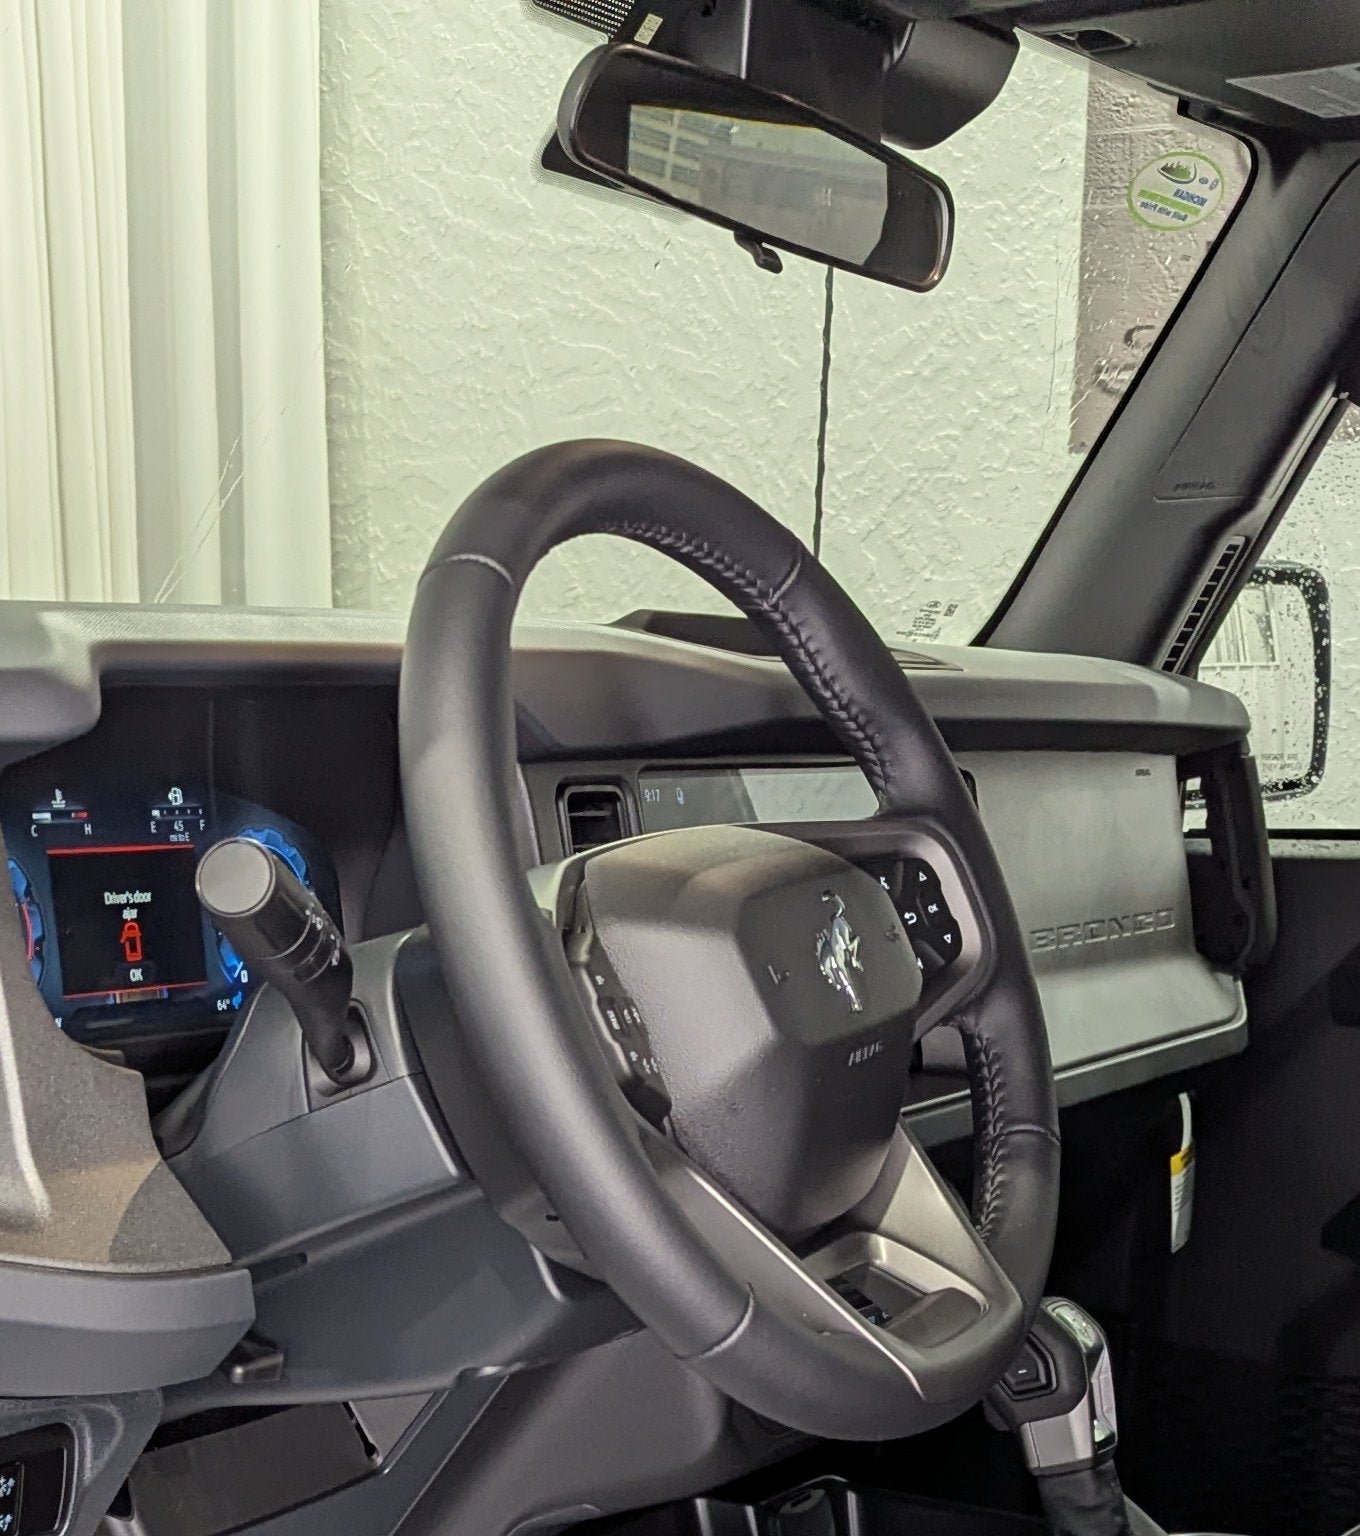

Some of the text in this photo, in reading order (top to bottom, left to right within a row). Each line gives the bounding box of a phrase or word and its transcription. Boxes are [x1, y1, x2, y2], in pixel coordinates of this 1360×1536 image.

[31, 824, 38, 837] C
[84, 822, 92, 835] H
[150, 820, 158, 833] E
[199, 819, 206, 831] F
[1029, 907, 1177, 953] BRONCO
[129, 968, 143, 982] OK
